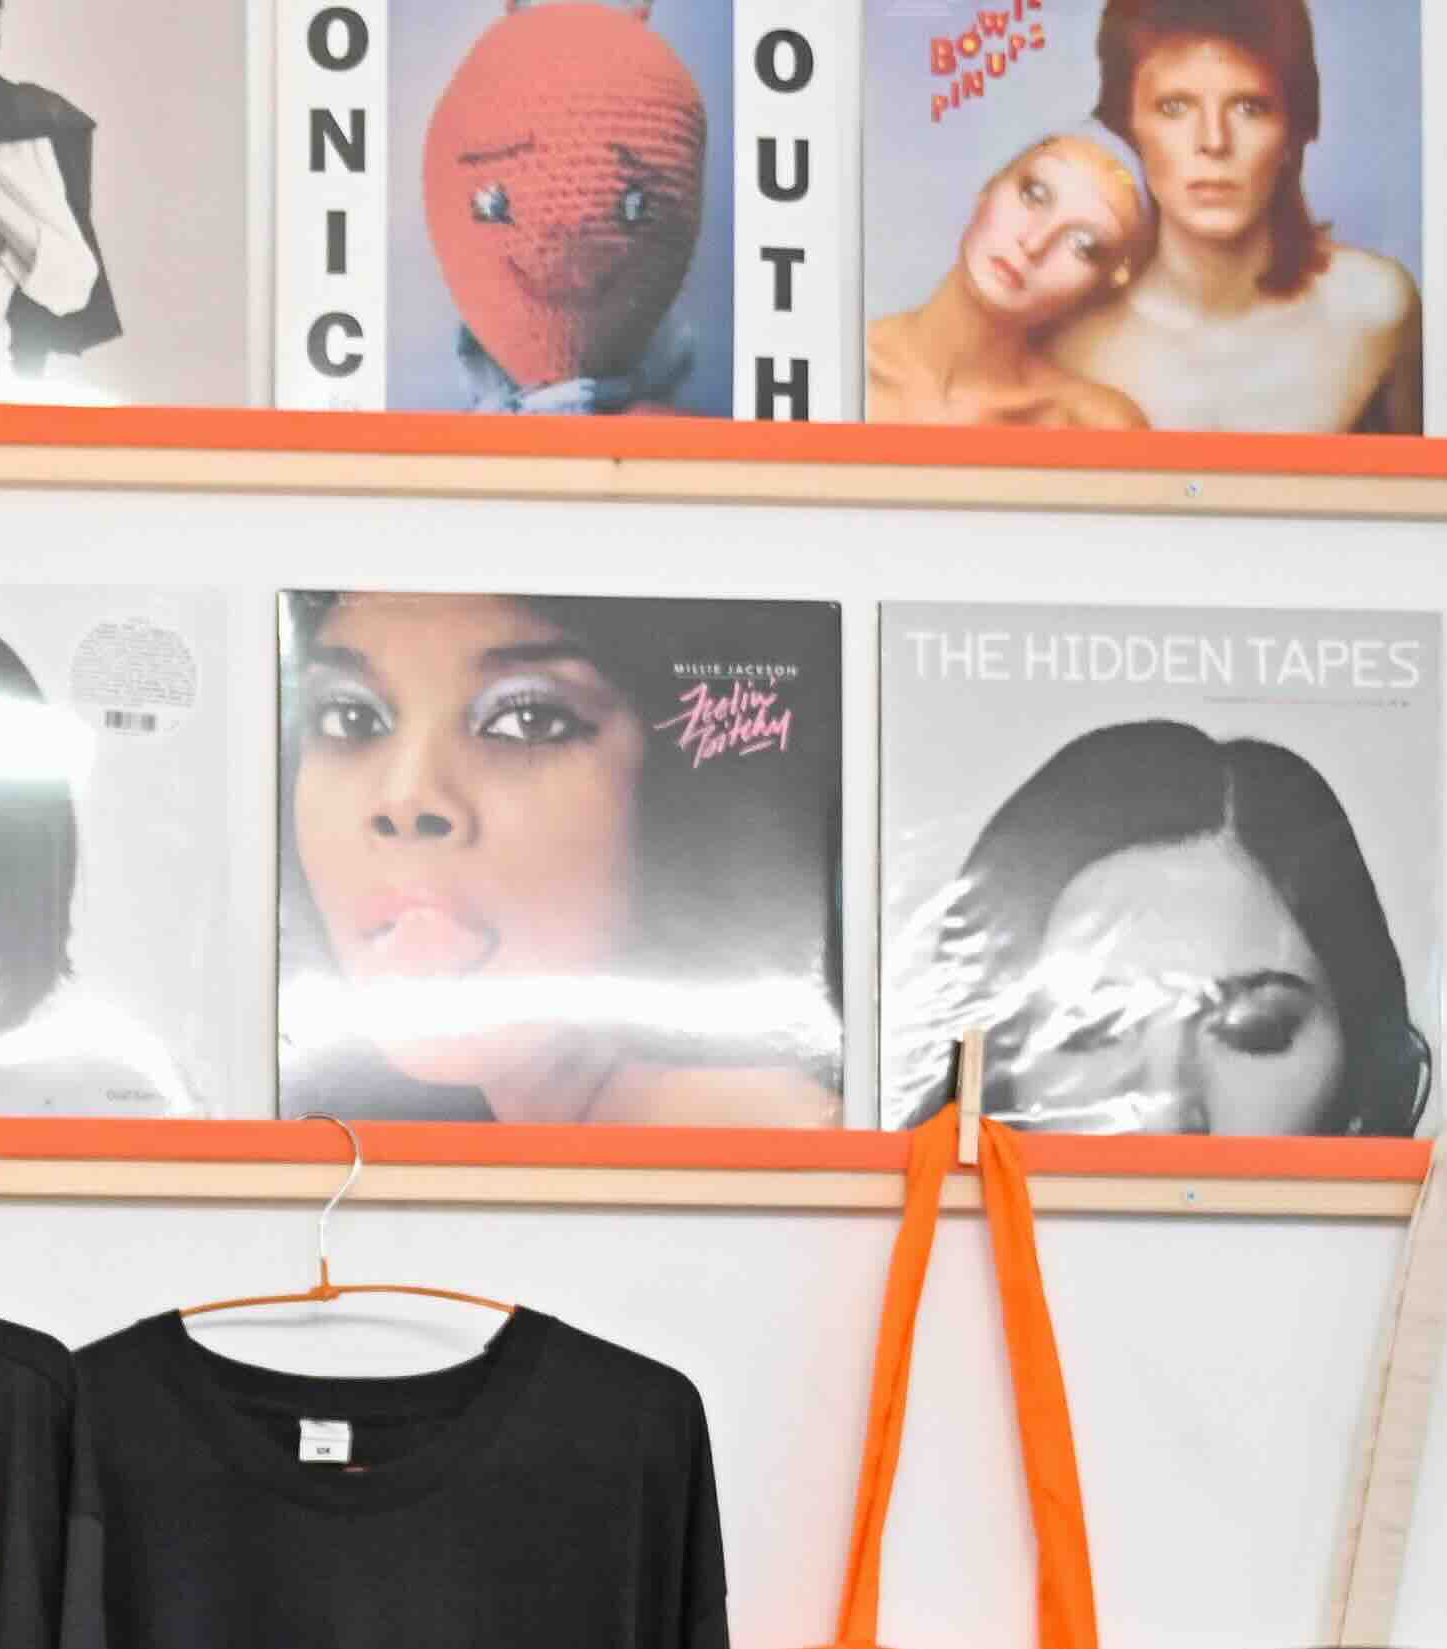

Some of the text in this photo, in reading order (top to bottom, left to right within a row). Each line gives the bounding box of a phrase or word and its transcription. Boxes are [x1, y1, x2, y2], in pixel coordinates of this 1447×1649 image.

[673, 662, 798, 678] MILLIE JACKSON
[904, 630, 1420, 689] THE HIDDEN TAPES
